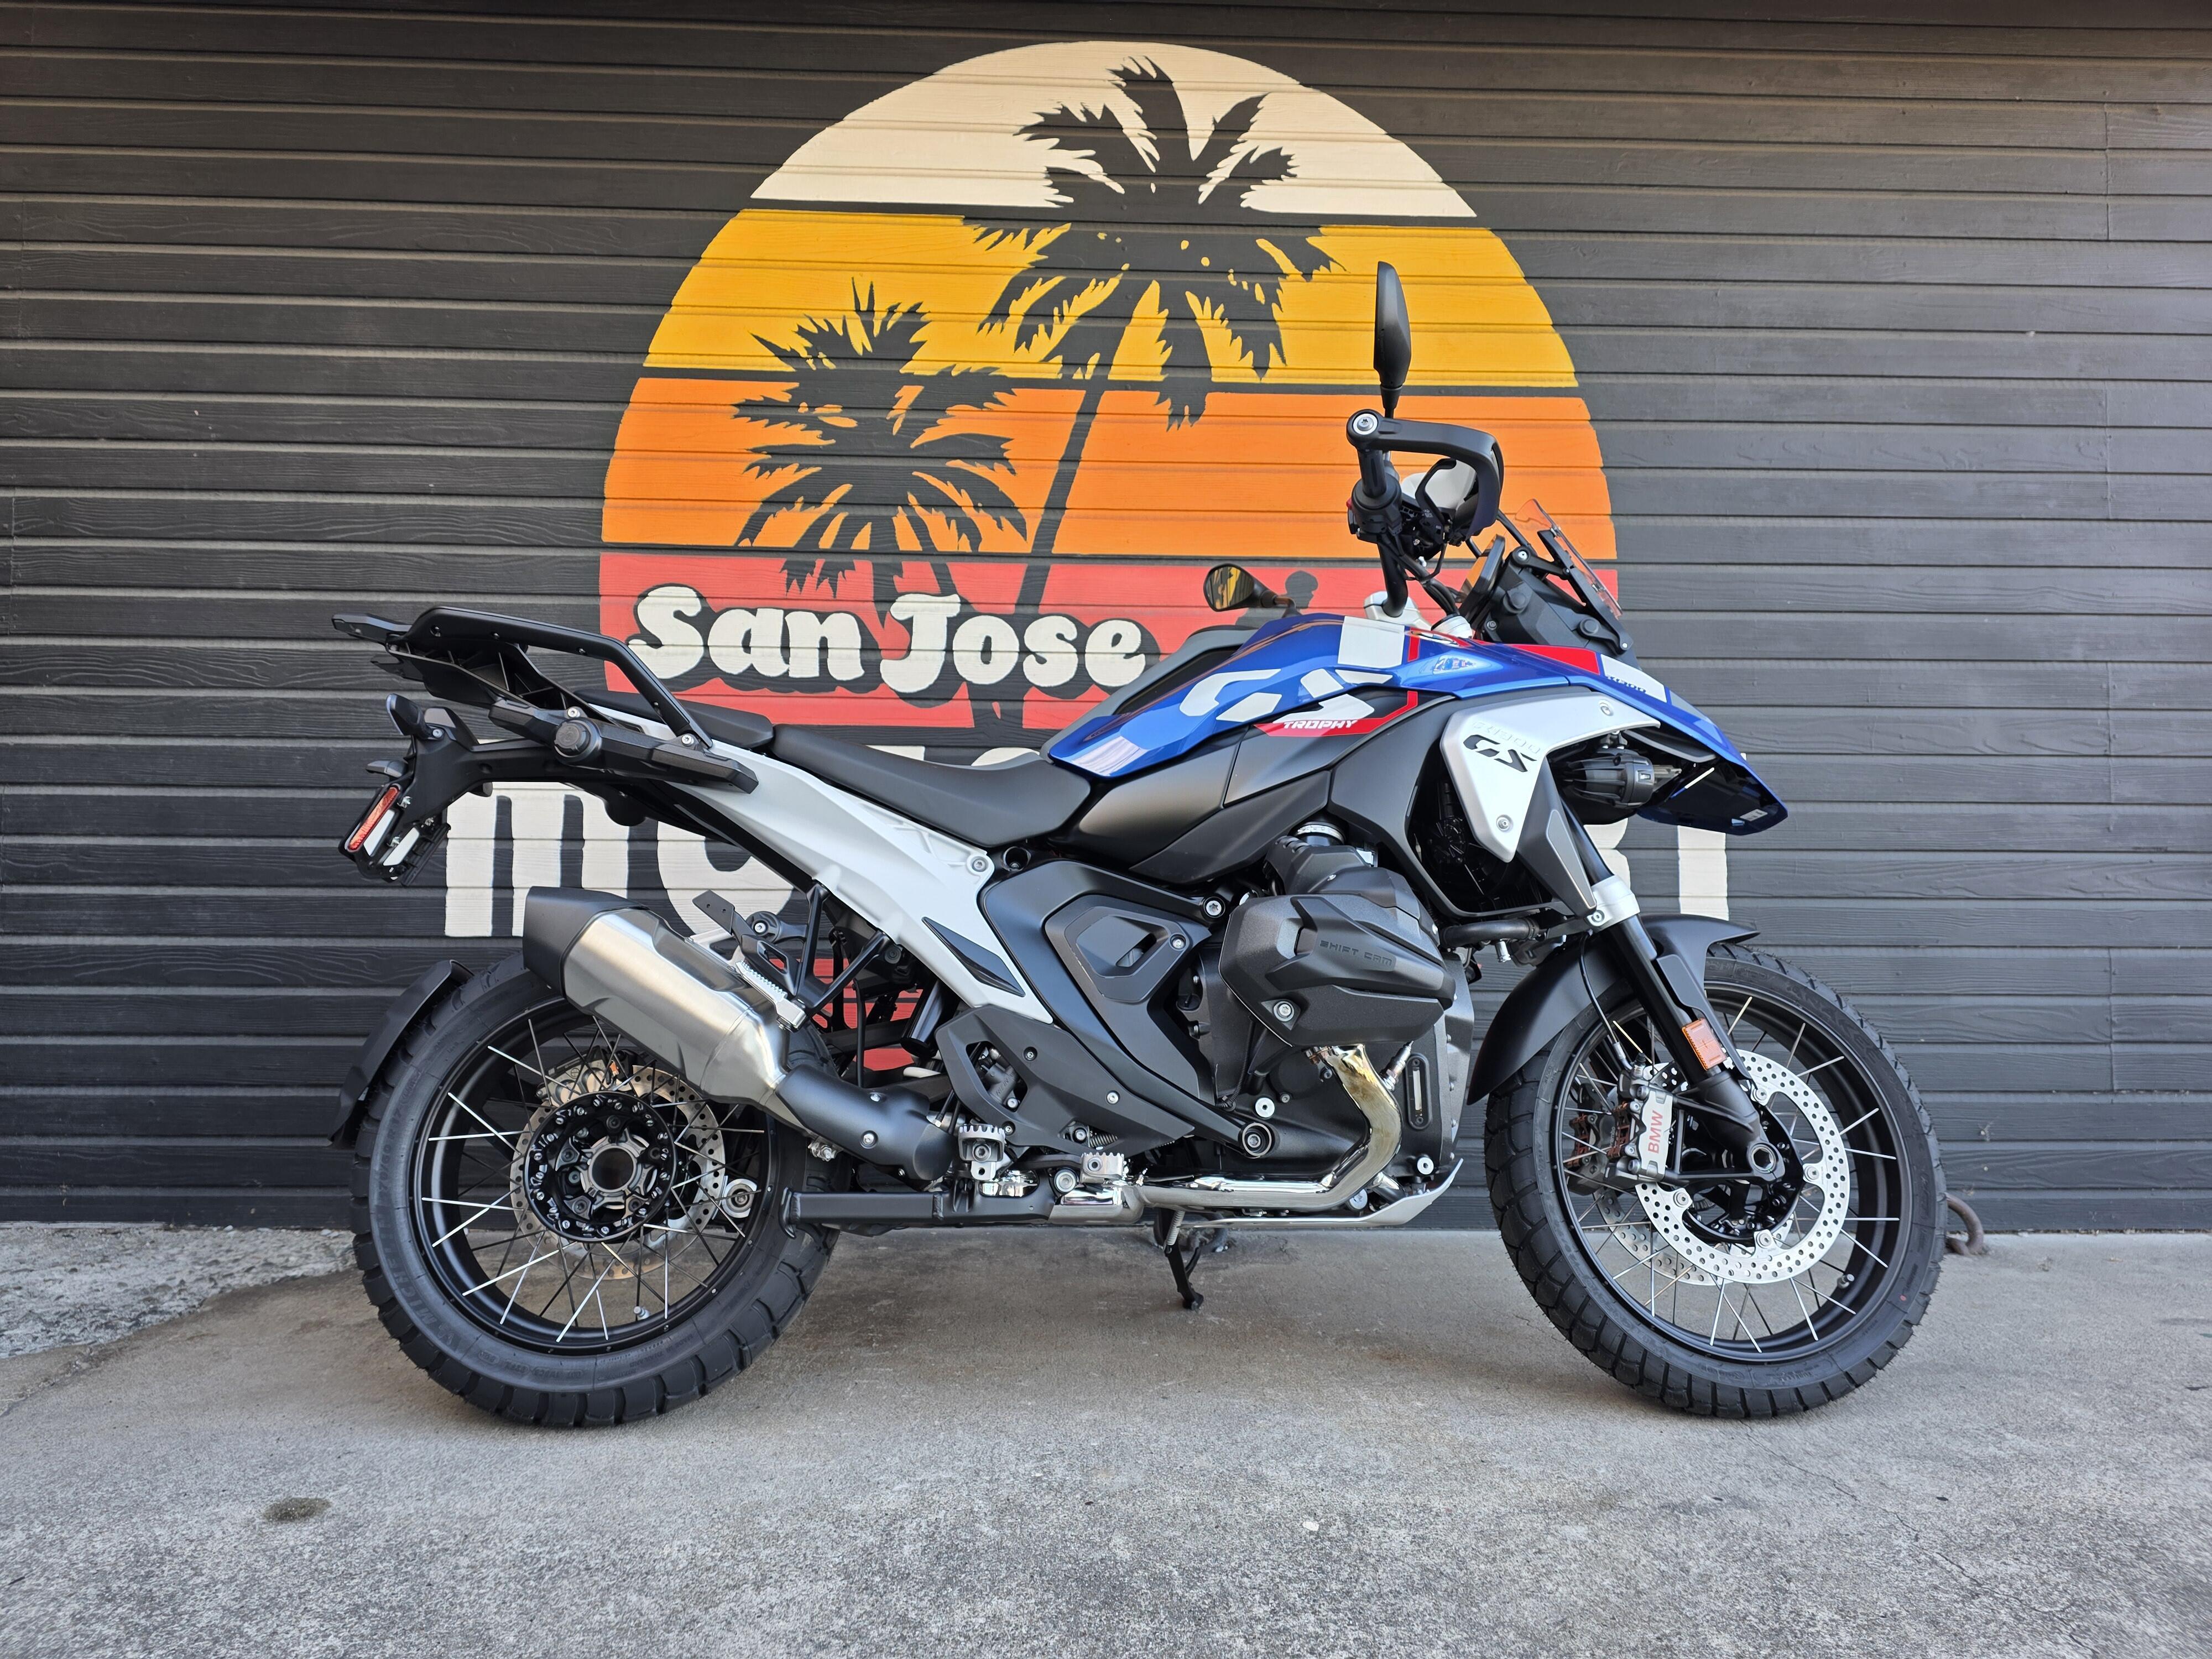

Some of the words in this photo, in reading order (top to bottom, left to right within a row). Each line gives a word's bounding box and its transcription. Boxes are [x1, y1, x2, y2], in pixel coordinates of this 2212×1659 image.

[628, 585, 865, 680] San
[879, 592, 1146, 693] Jose
[1284, 719, 1358, 729] TROPHY
[1463, 734, 1537, 773] GS
[1319, 940, 1359, 956] SHIFT
[1364, 952, 1392, 966] CAM
[1647, 1110, 1663, 1154] BMW
